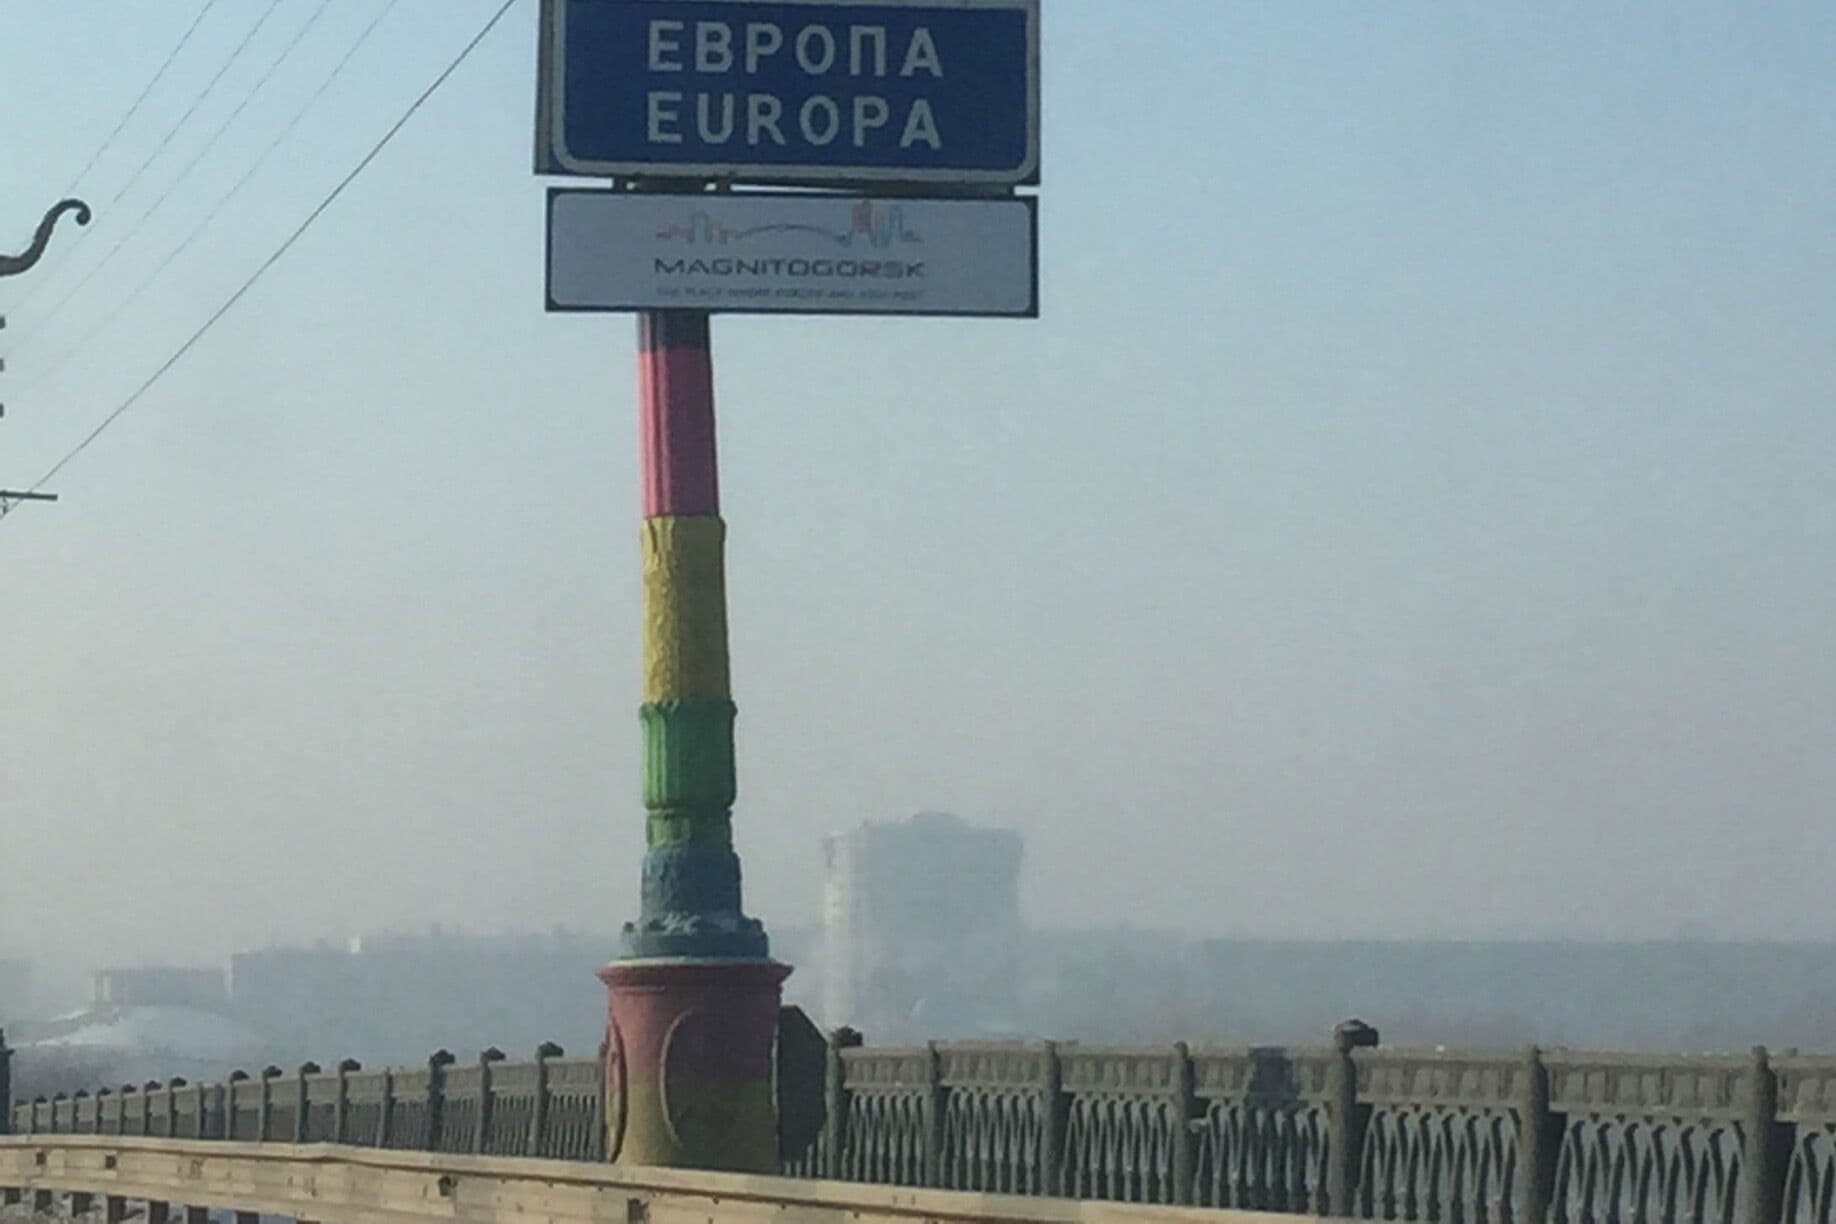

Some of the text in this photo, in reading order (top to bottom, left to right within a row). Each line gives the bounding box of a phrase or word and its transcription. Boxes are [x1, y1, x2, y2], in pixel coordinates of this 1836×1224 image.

[648, 20, 943, 76] ЕВРОПА
[646, 91, 941, 149] EUROPA
[655, 258, 926, 278] MAGNITOGORSK
